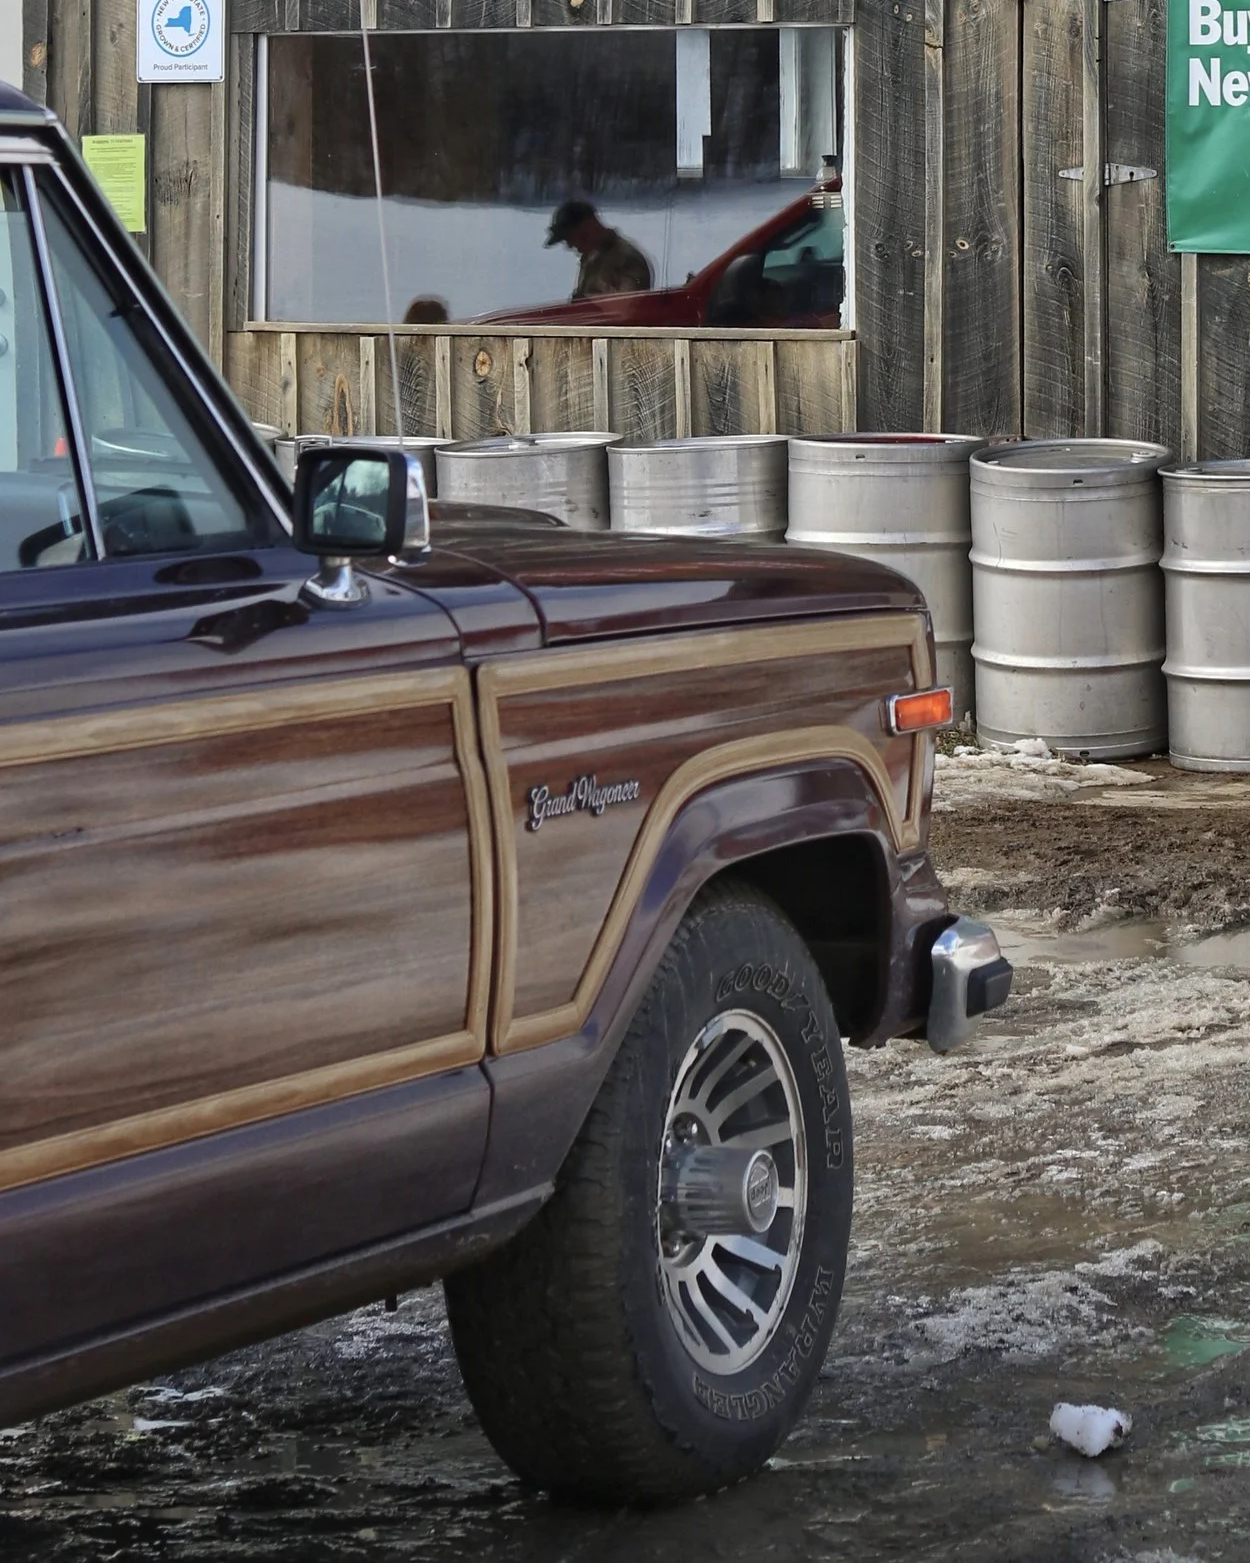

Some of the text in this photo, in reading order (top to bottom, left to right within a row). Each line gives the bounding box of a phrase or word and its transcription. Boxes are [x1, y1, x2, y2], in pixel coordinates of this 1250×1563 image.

[157, 0, 169, 16] NEW
[156, 24, 174, 50] GROWN
[180, 23, 206, 52] CERTIFIED
[153, 63, 208, 71] Proud Participant
[531, 774, 640, 830] Grand Wagoneer
